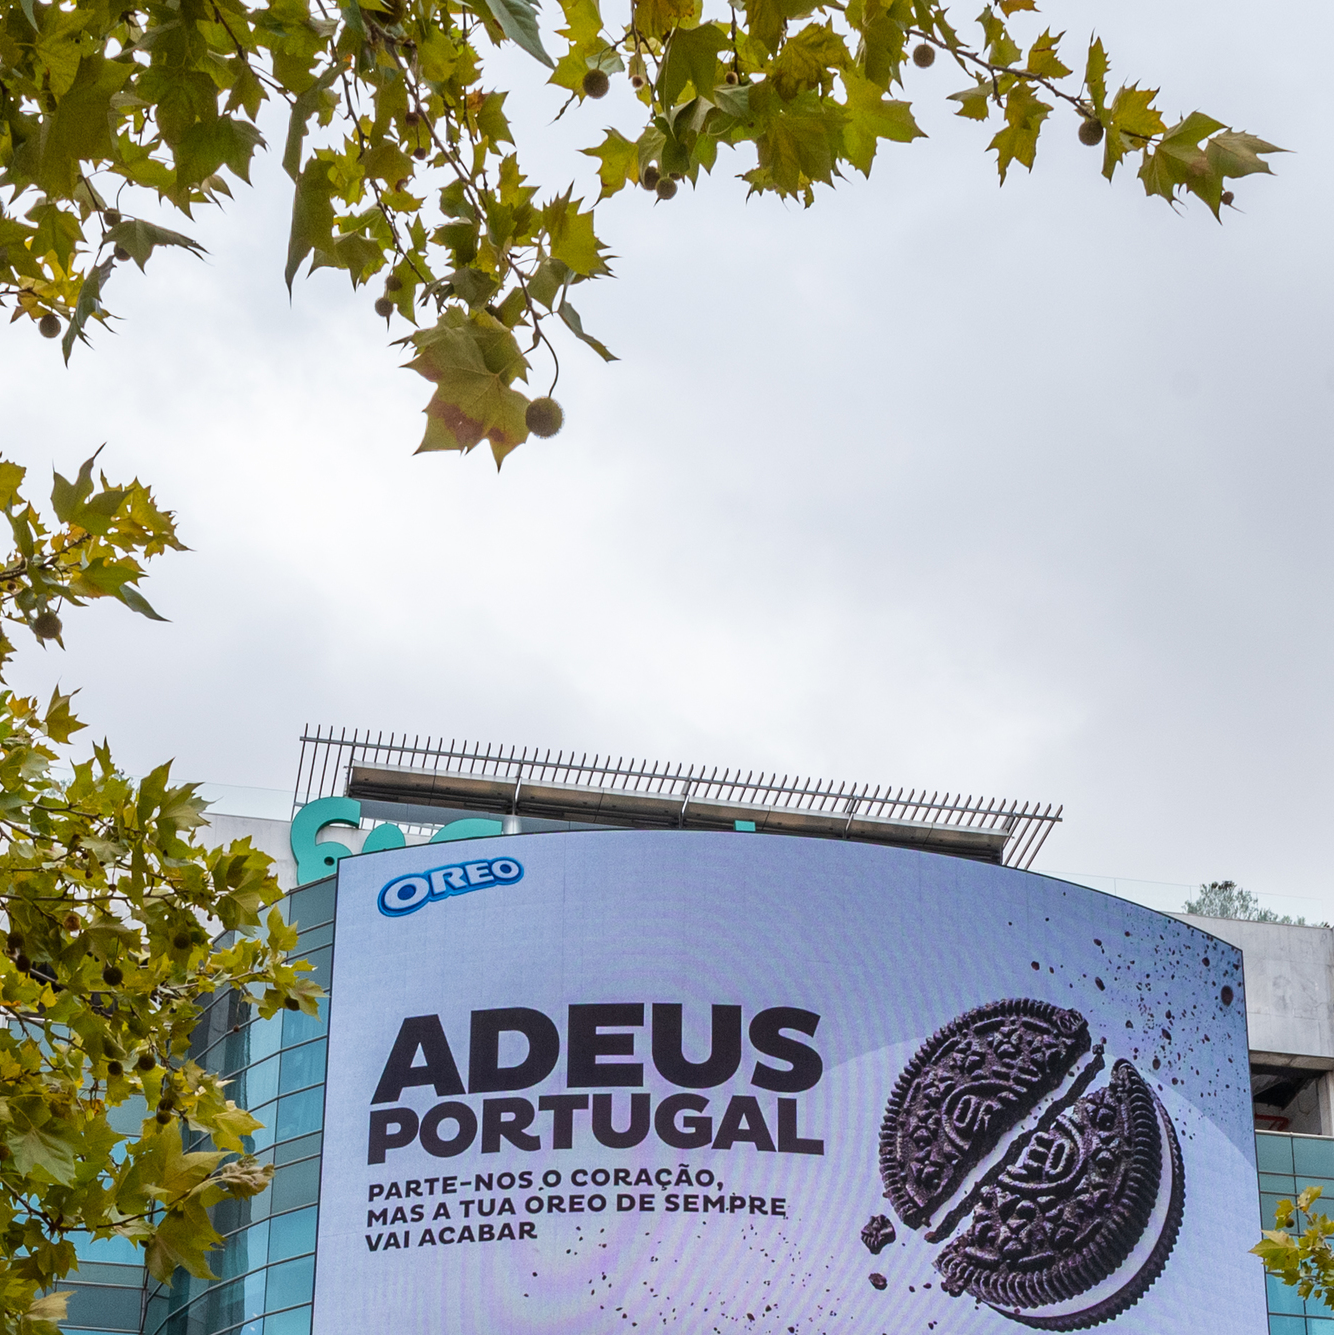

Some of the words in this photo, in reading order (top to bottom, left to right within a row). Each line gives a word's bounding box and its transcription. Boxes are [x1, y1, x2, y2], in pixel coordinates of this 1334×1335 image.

[379, 857, 523, 916] OREO
[370, 1002, 823, 1105] ADEUS
[367, 1093, 824, 1165] PORTUGAL
[367, 1171, 534, 1202] PARTE-NOS
[542, 1169, 563, 1188] O
[570, 1164, 724, 1192] CORAÇÃO,
[366, 1203, 425, 1228] MAS
[432, 1203, 452, 1222] A
[459, 1198, 517, 1219] TUA
[524, 1193, 608, 1215] OREO
[616, 1193, 656, 1213] DE
[664, 1194, 787, 1217] SEMPRE
[365, 1231, 411, 1252] VAI
[418, 1221, 538, 1247] ACABAR
